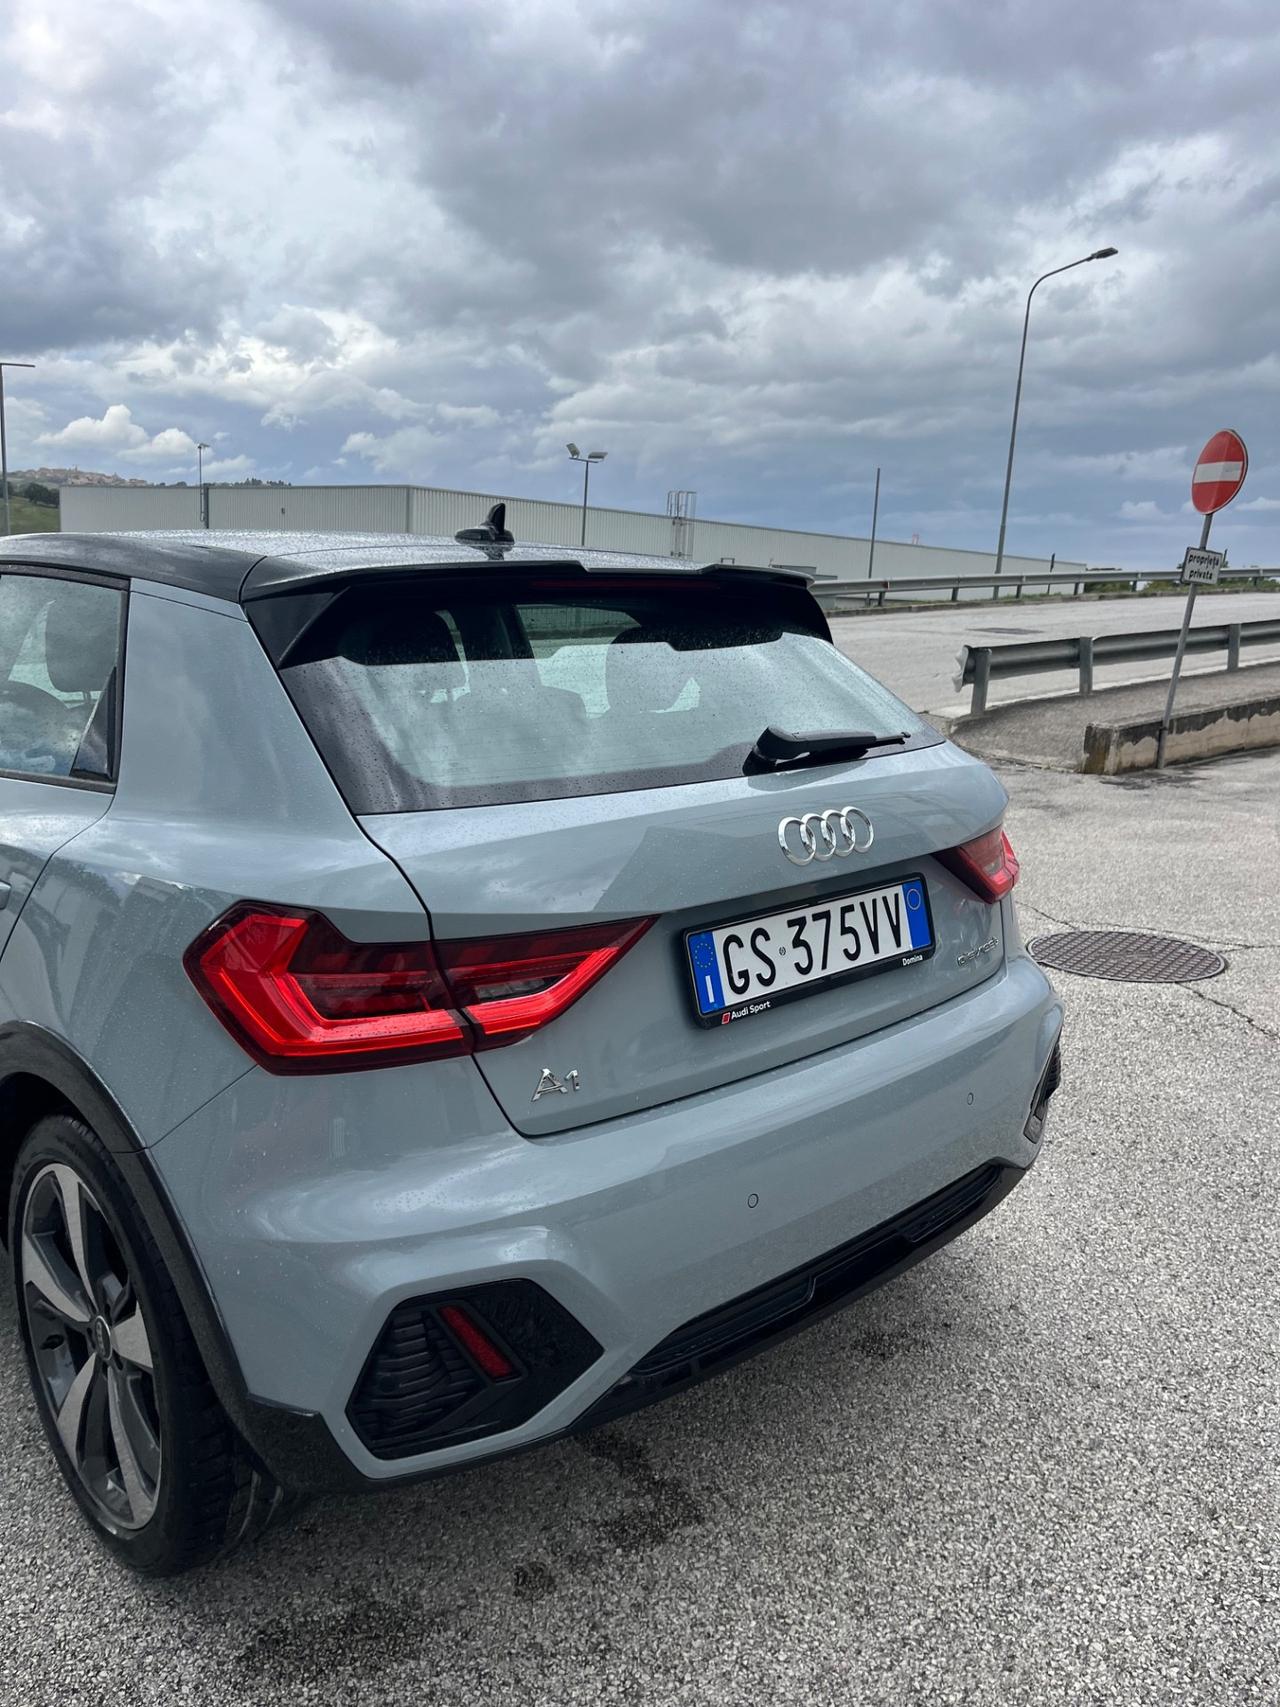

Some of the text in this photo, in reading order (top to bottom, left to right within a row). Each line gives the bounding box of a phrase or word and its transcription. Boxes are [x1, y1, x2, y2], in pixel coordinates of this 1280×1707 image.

[722, 927, 777, 995] GS
[786, 892, 902, 976] 375VV
[902, 954, 923, 966] Domina
[731, 1001, 771, 1020] Audi Sport
[530, 1068, 580, 1102] A1
